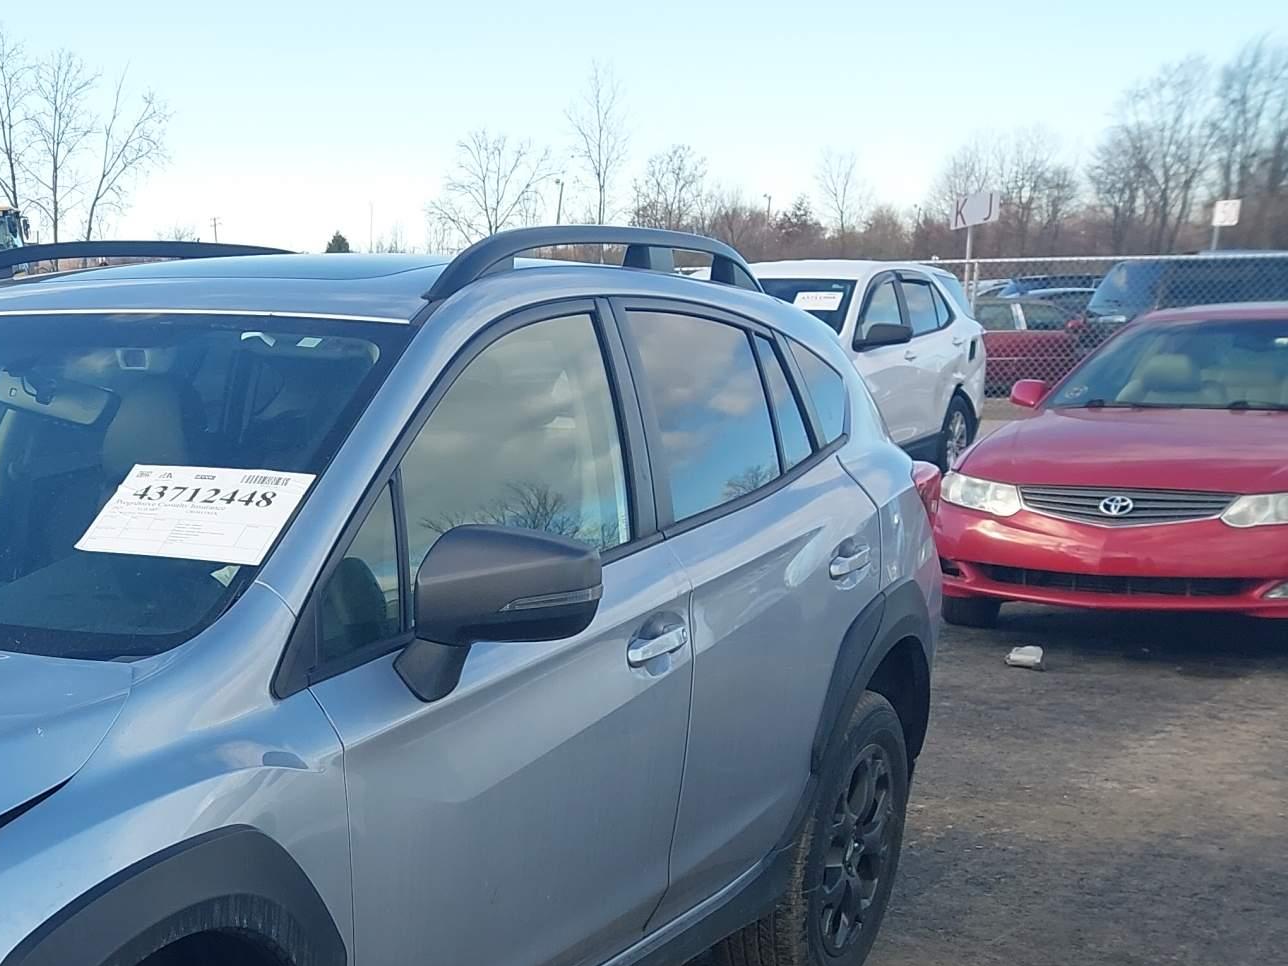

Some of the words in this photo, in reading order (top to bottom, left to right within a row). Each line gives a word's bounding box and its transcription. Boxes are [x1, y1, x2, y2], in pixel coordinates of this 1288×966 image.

[955, 199, 968, 227] K
[983, 192, 993, 221] J
[132, 484, 277, 508] 43712448
